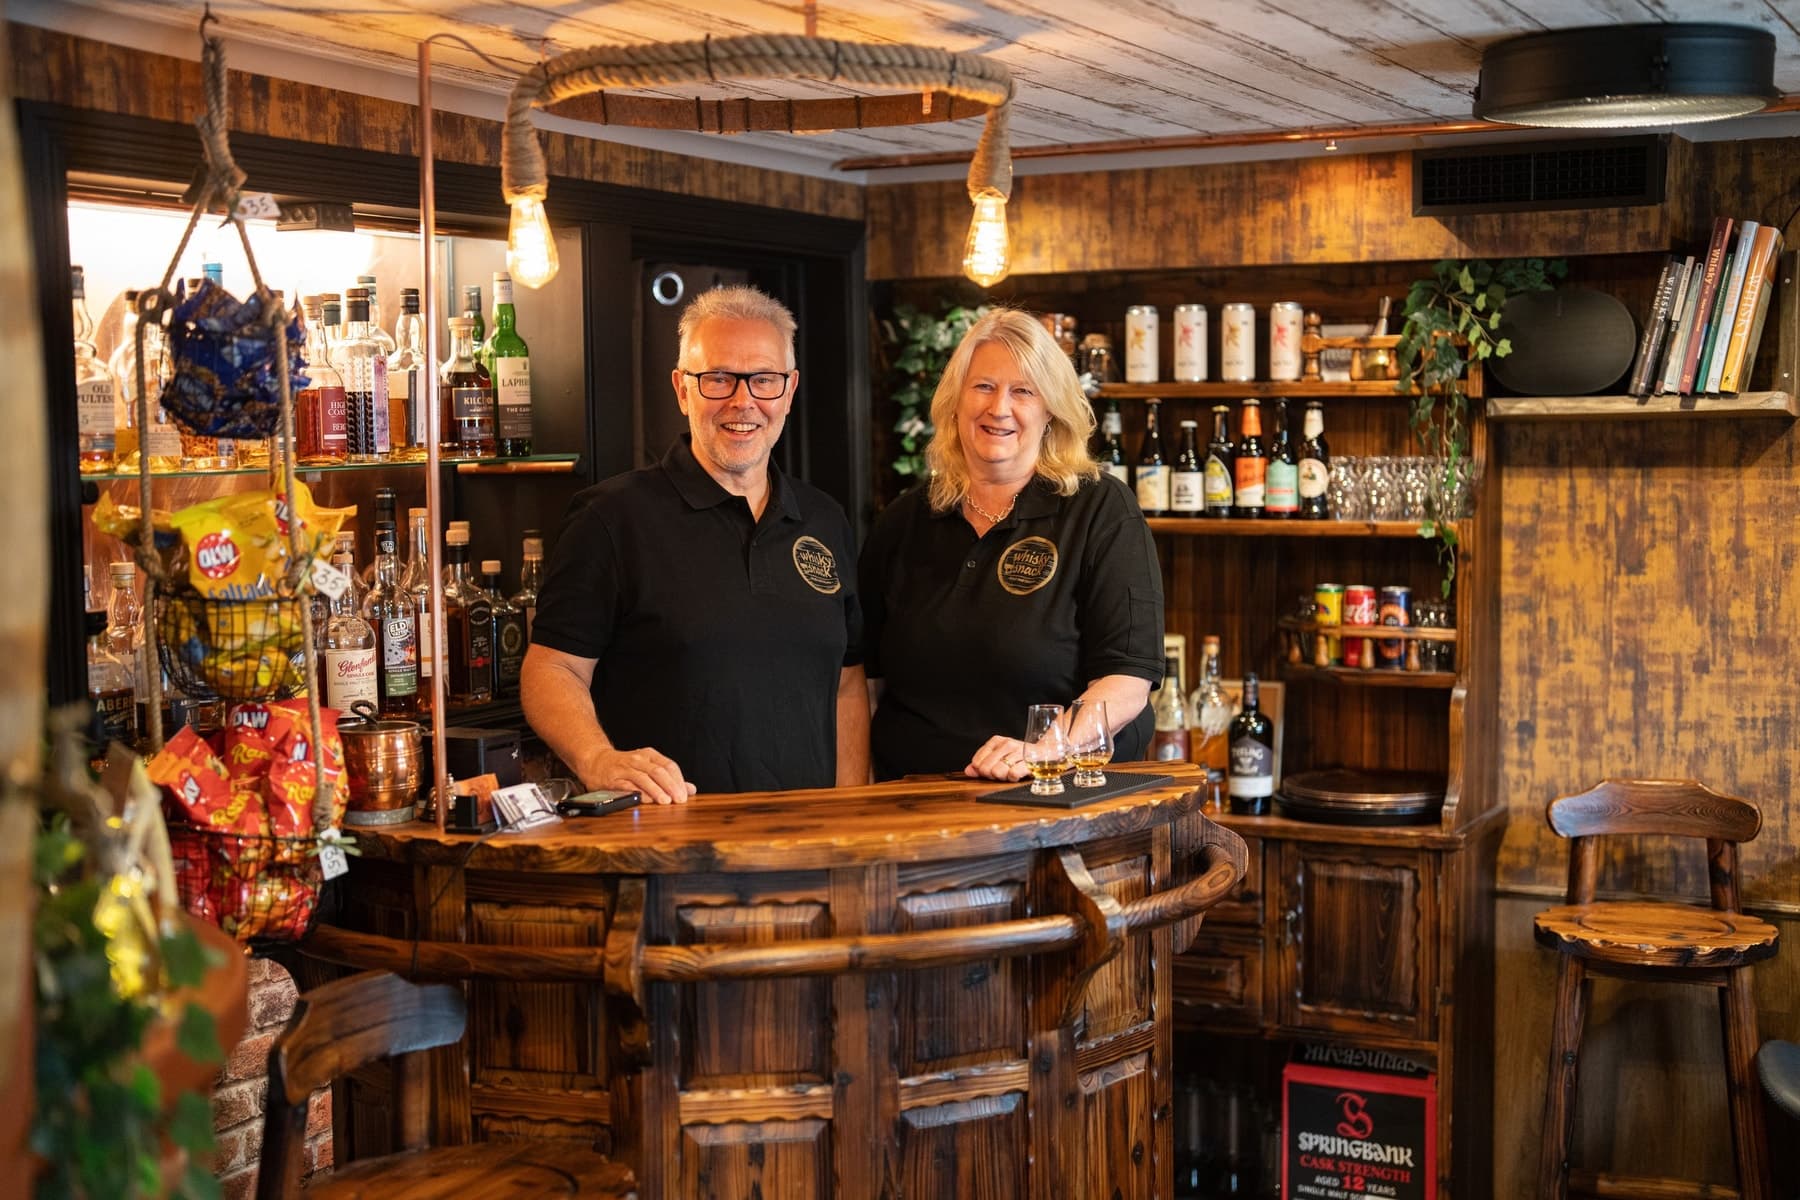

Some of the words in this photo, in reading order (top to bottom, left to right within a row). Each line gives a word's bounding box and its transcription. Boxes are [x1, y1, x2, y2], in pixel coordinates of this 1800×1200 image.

[1704, 248, 1720, 284] Whisky
[1657, 276, 1675, 322] WHISKY
[1735, 274, 1762, 337] WHISKY
[198, 543, 235, 568] OLW
[1014, 550, 1048, 569] whisky
[389, 621, 408, 635] ELD
[1298, 1131, 1415, 1167] SPRINGBANK
[1299, 1154, 1336, 1172] CASK
[1338, 1161, 1411, 1184] STRENGTH
[1297, 1184, 1326, 1197] SINGLE
[1314, 1175, 1340, 1187] AGED
[1342, 1174, 1366, 1191] 12
[1367, 1183, 1397, 1197] YEARS
